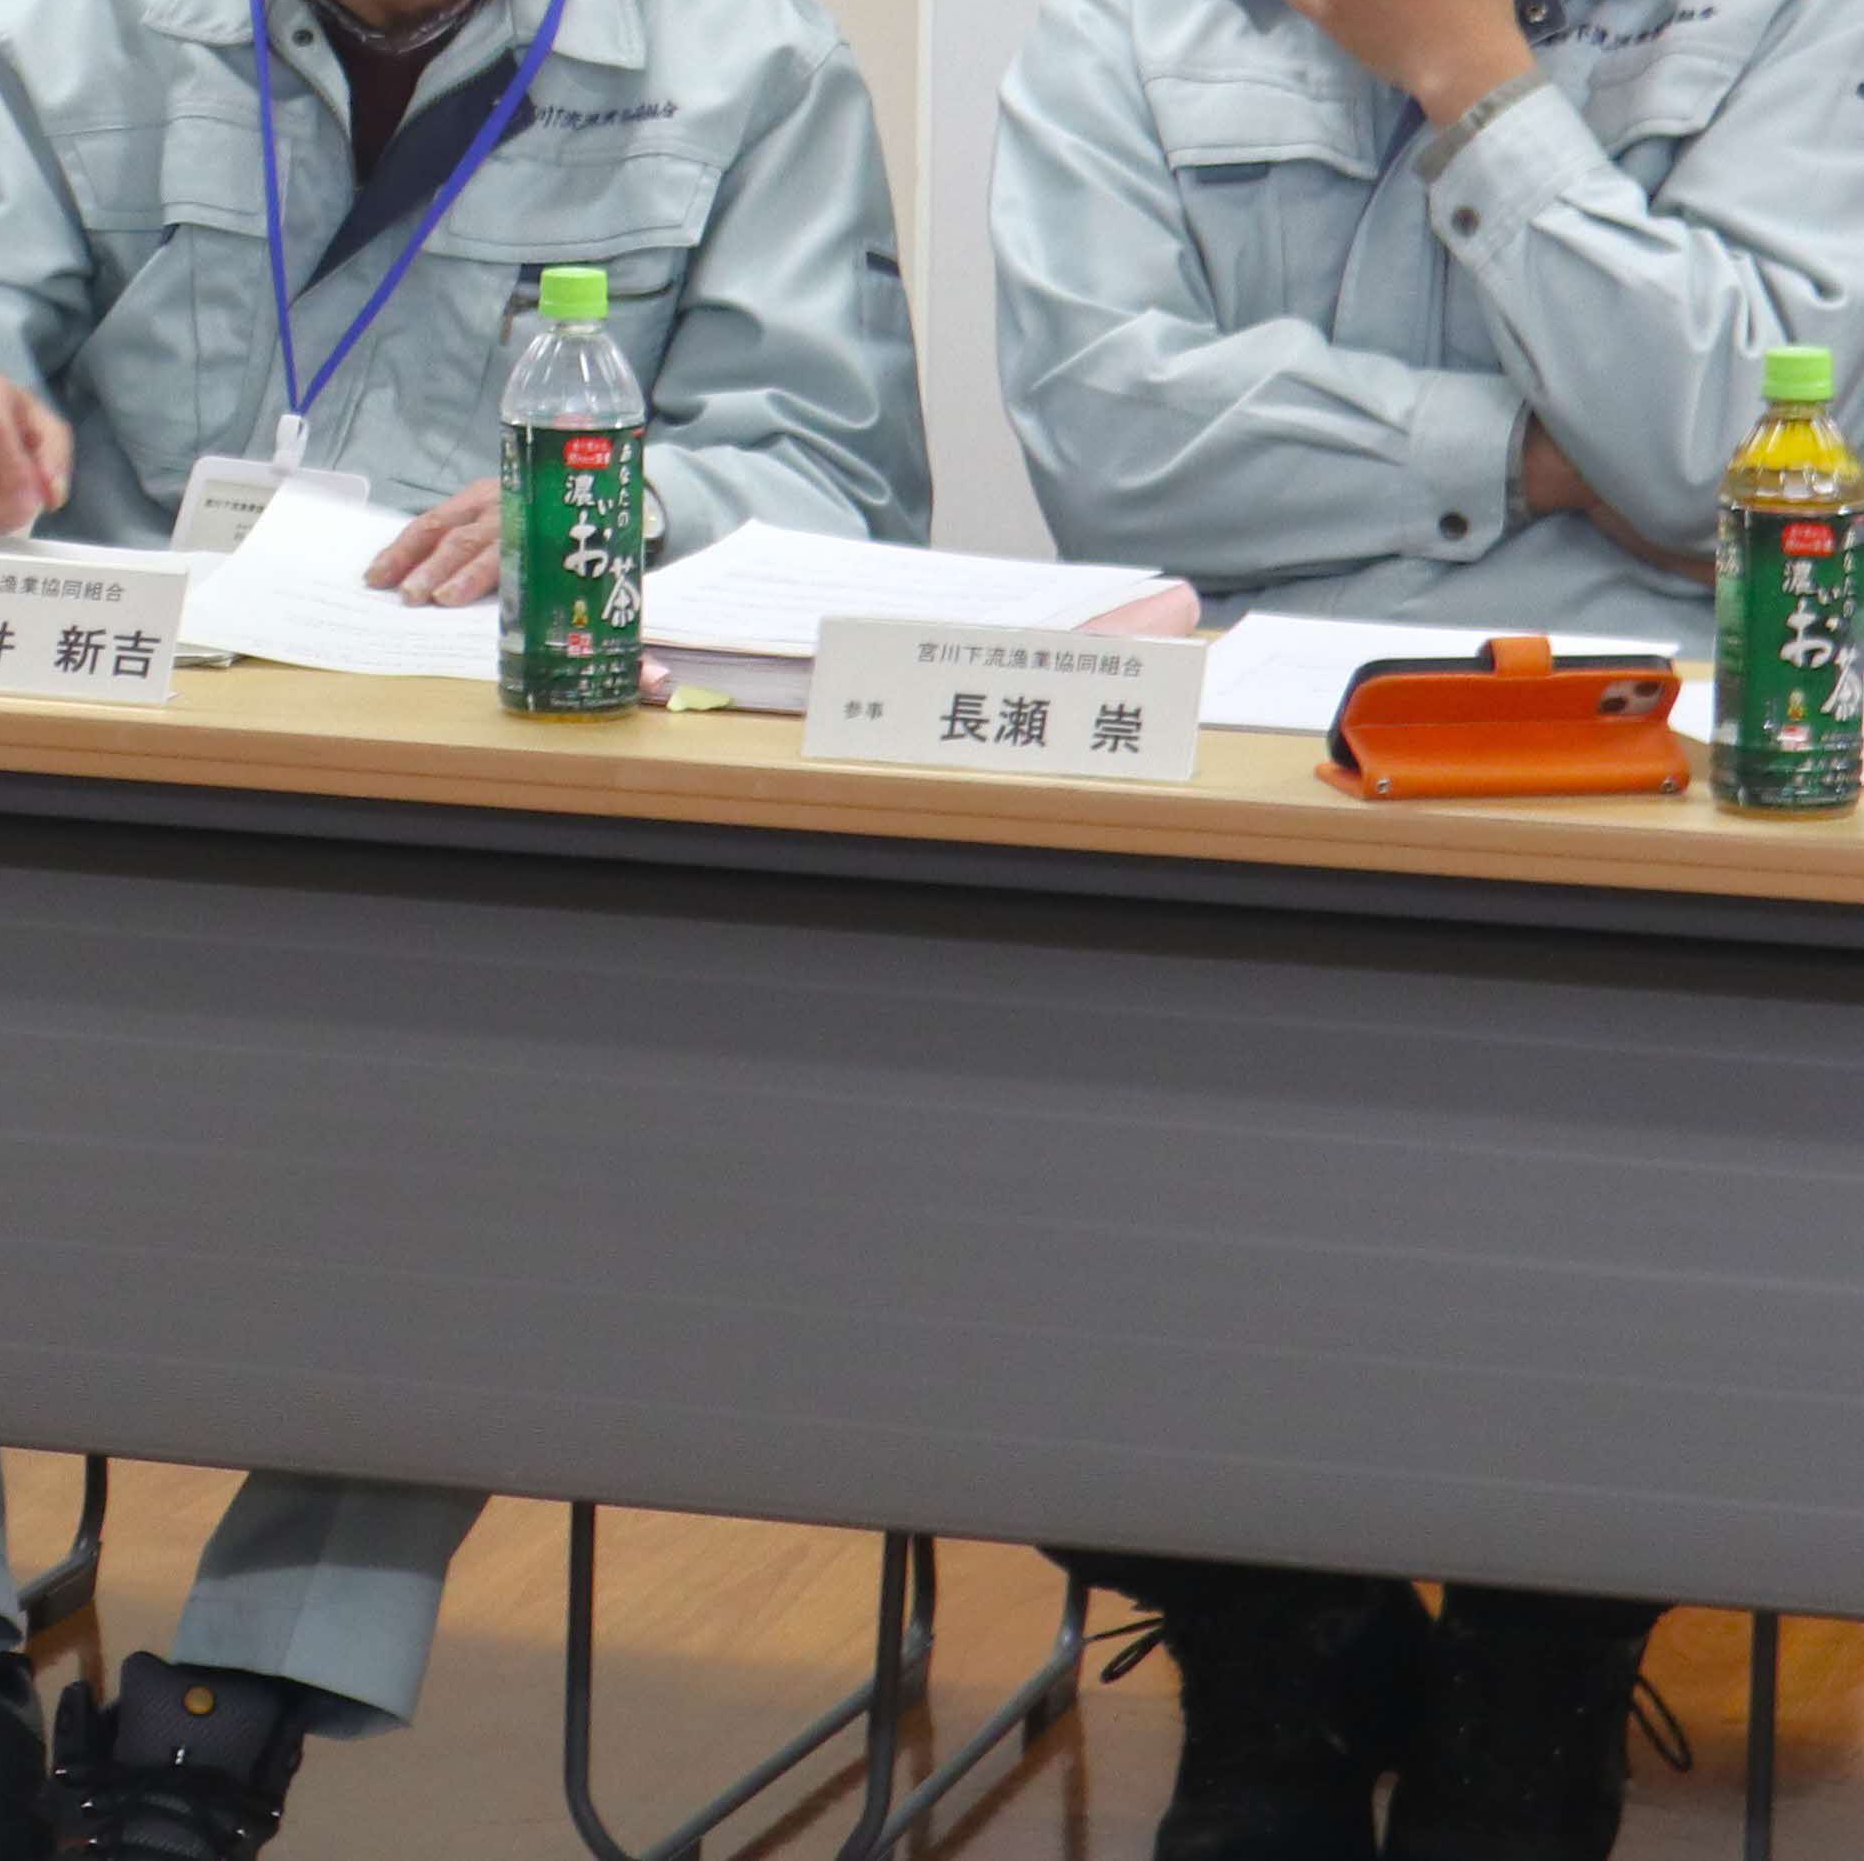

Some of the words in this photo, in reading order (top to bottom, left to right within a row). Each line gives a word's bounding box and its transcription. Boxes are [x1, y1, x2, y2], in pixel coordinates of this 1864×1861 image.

[53, 624, 161, 679] 新吉
[916, 642, 1144, 678] 宮川下流漁業協同組合
[939, 693, 1051, 748] 長瀬
[1090, 703, 1143, 754] 崇
